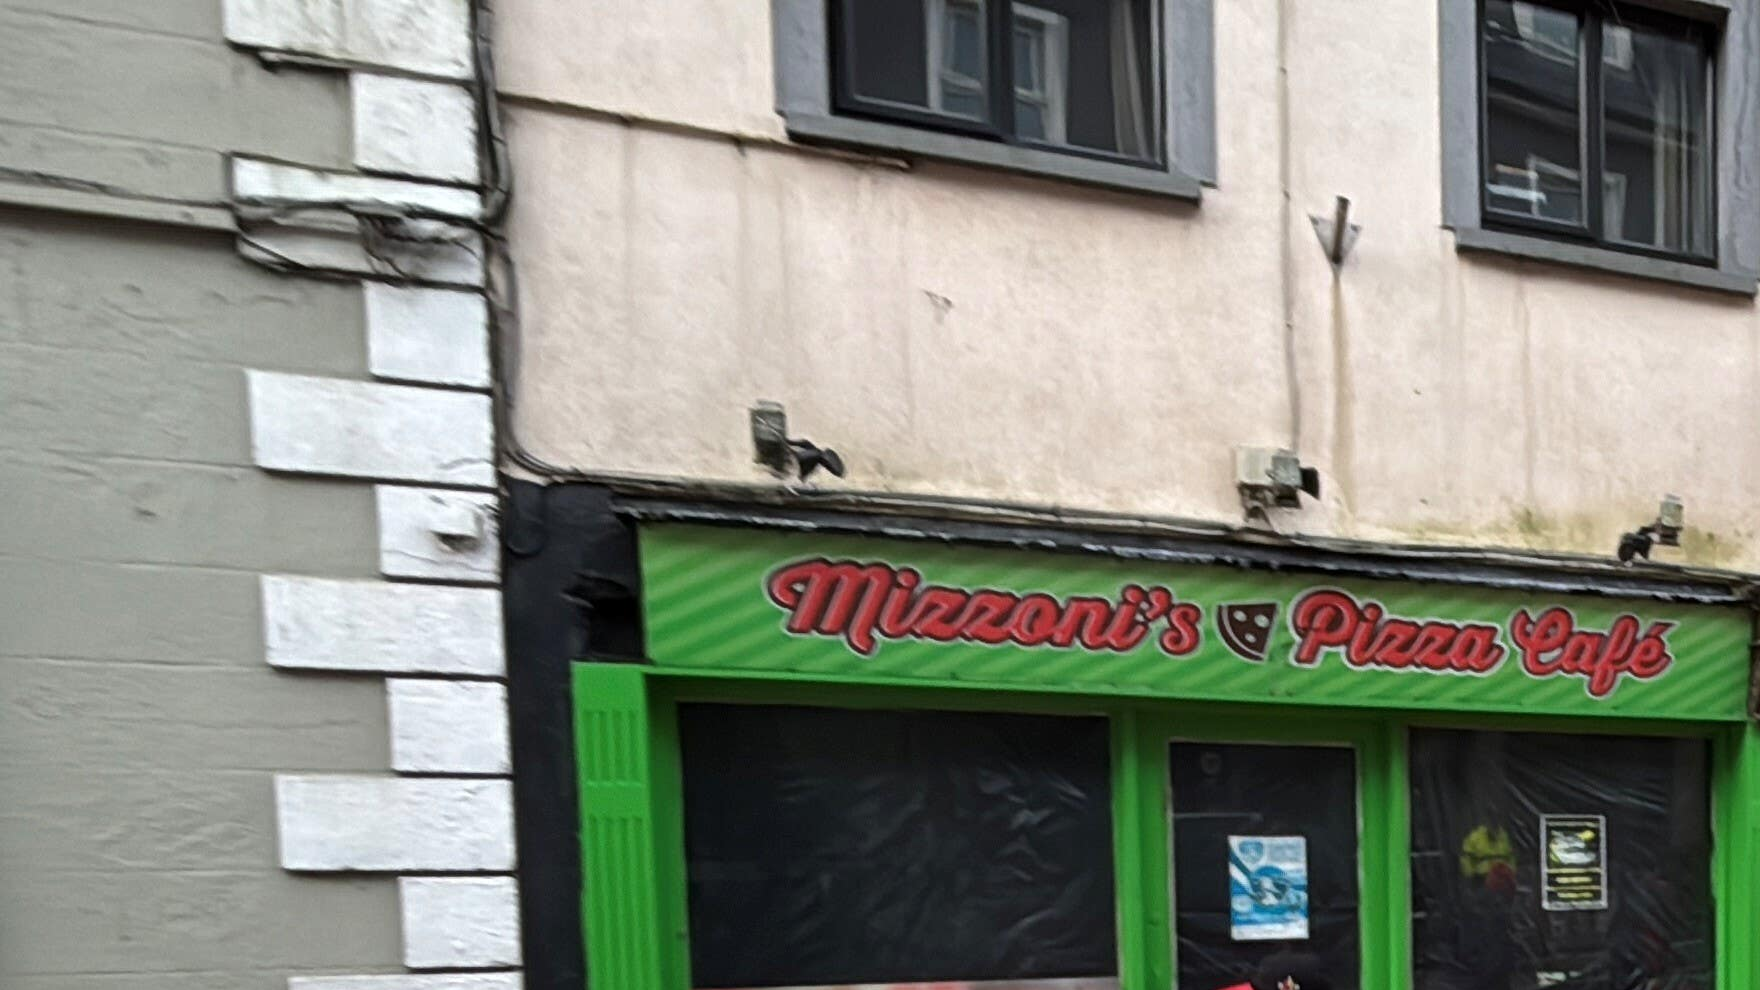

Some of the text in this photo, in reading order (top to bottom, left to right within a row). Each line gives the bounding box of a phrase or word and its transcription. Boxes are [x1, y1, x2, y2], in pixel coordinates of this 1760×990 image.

[765, 556, 1677, 700] Mizzoni's Pizza Café
